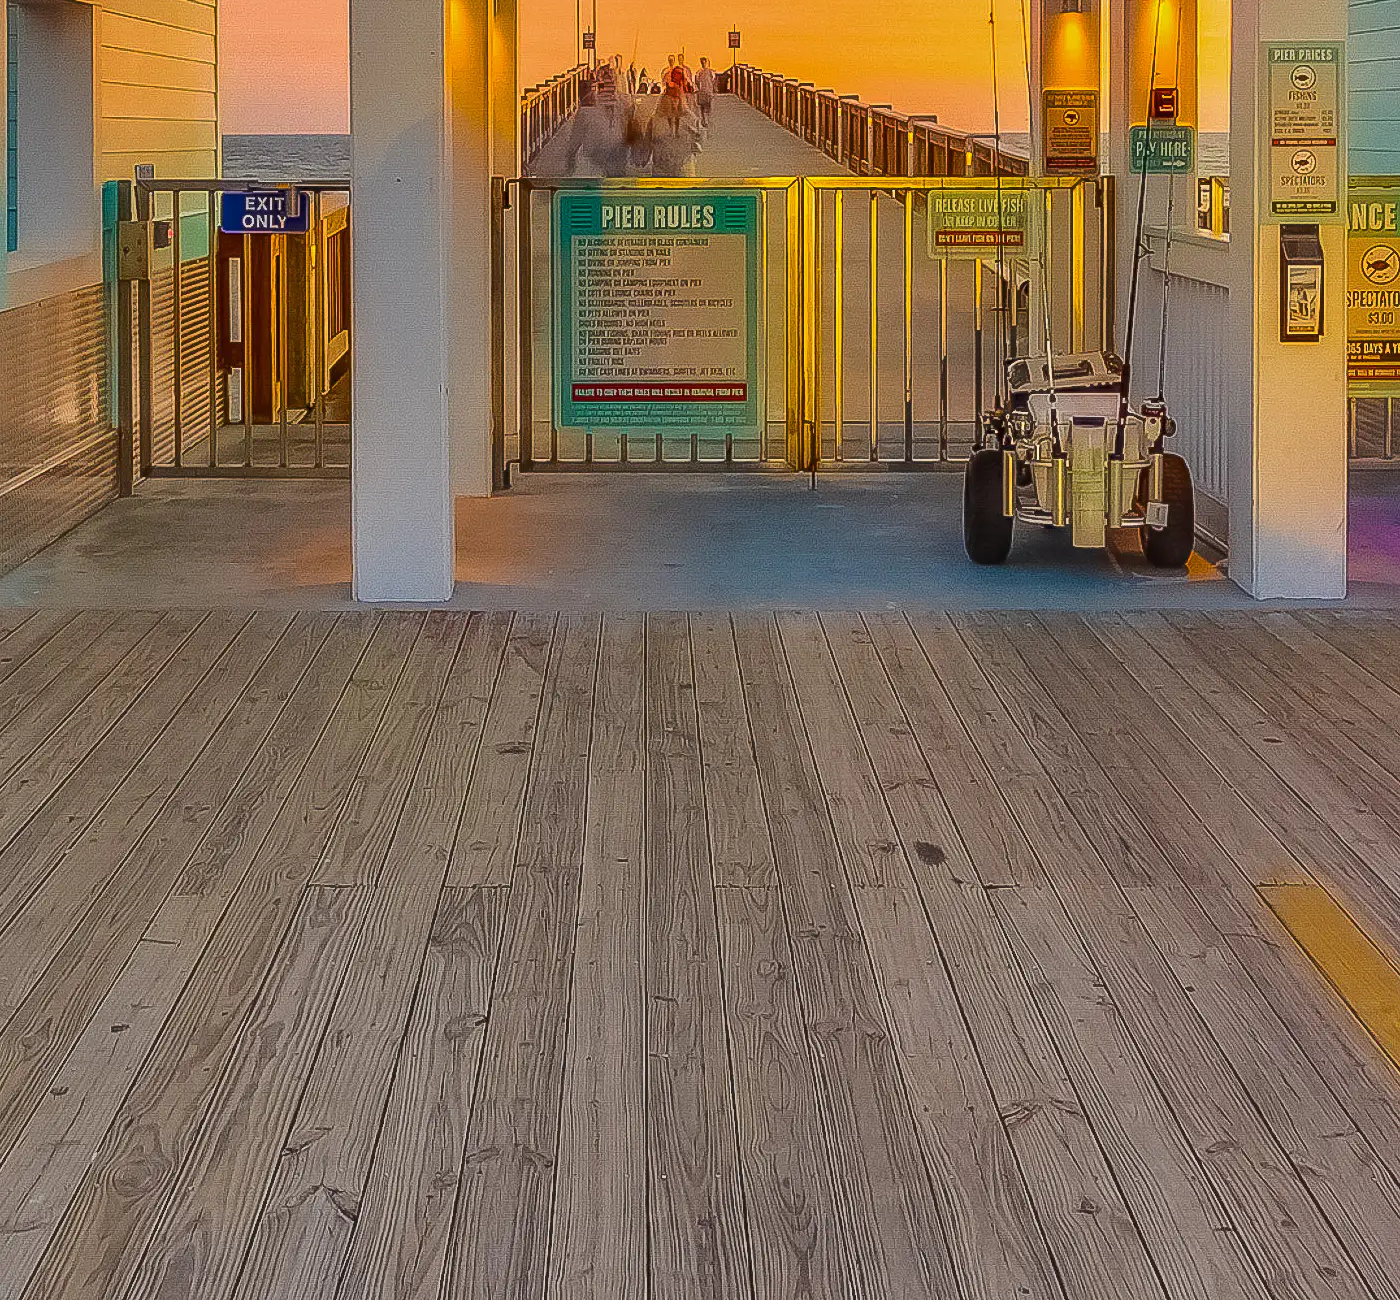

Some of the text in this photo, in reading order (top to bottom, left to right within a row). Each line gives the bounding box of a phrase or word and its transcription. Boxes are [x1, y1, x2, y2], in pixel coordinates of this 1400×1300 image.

[1273, 49, 1333, 61] PIER PRICES
[1160, 141, 1188, 157] HERE
[1280, 175, 1326, 187] SPECTATORS
[245, 196, 285, 211] EXIT
[935, 198, 1024, 213] RELEASE LIVE FISH
[242, 214, 287, 229] ONLY
[601, 205, 714, 228] PIER RULES
[955, 215, 975, 228] KEEP
[986, 215, 1017, 228] COLER
[1367, 311, 1394, 325] $3.00
[1363, 342, 1384, 355] DAYS
[1384, 342, 1391, 355] A
